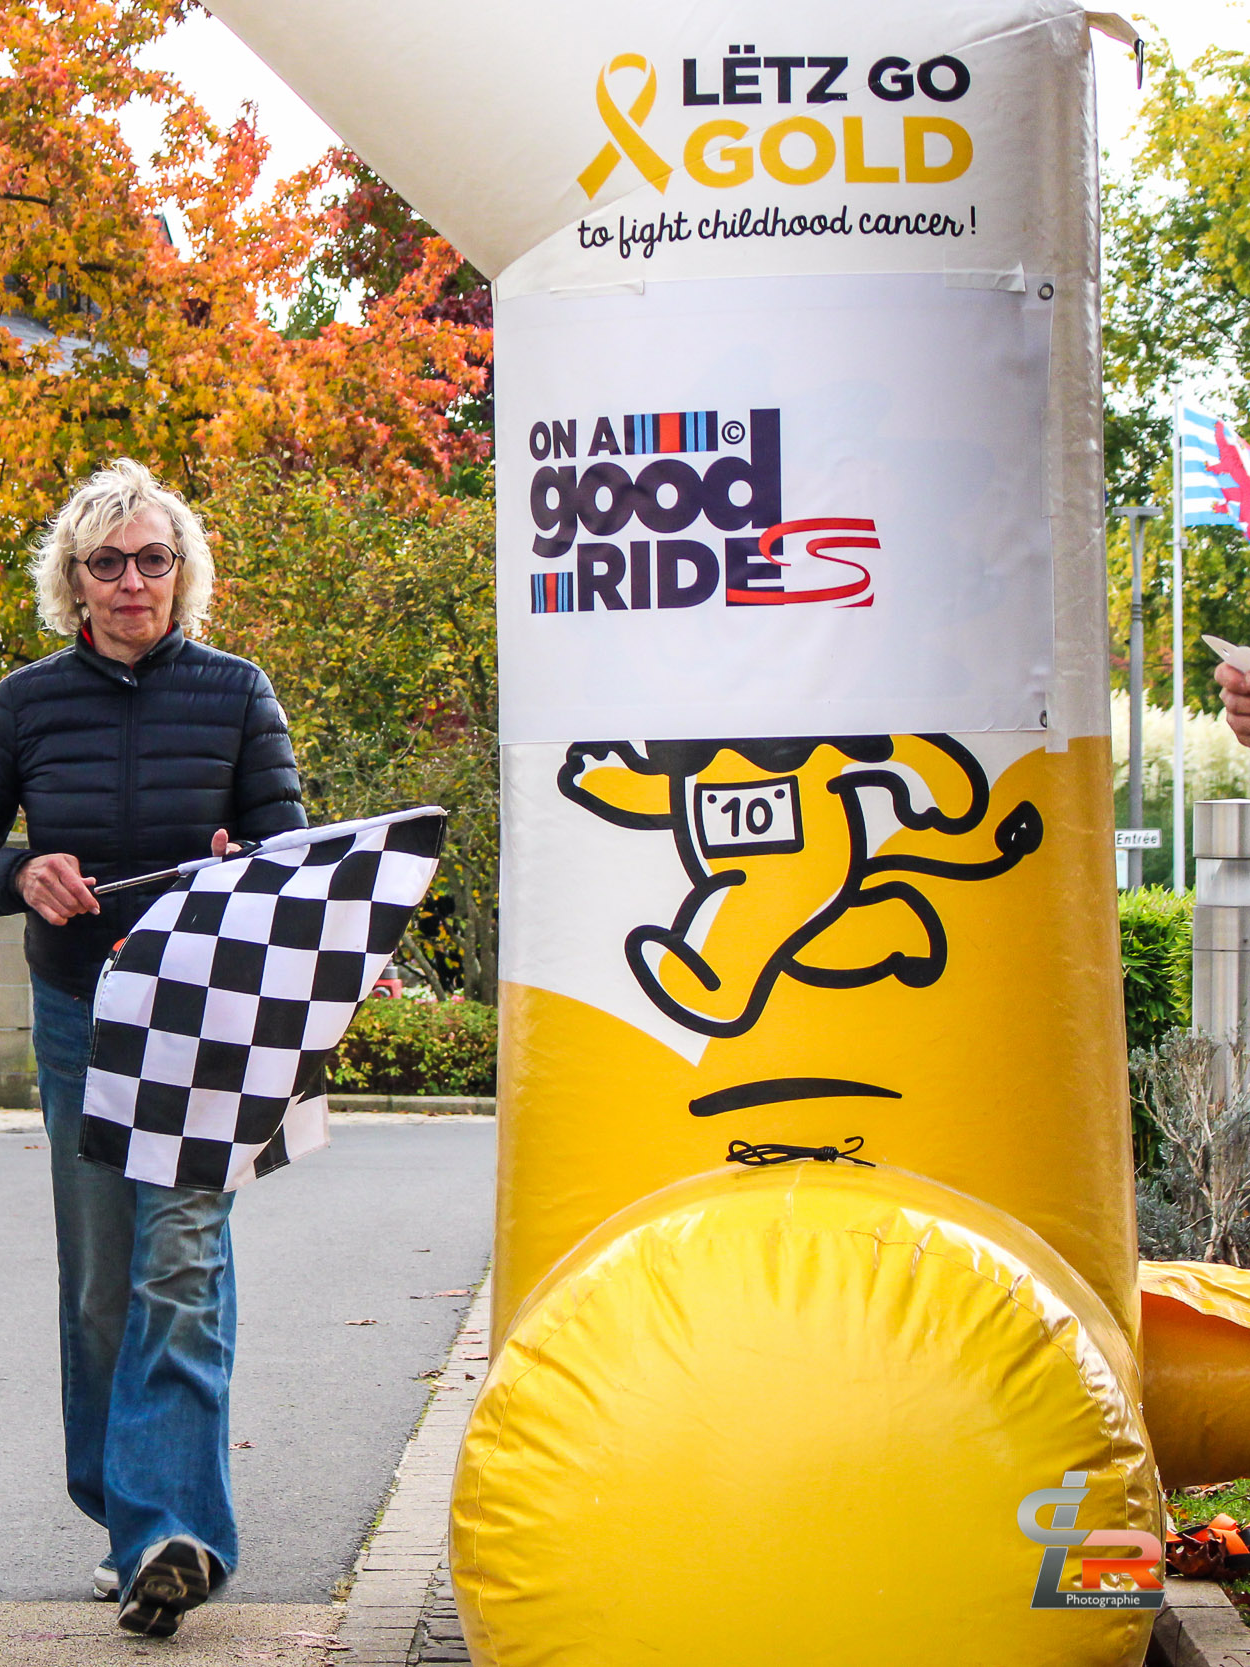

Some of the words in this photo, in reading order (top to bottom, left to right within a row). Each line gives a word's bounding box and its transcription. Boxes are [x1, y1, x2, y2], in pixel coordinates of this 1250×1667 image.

[682, 44, 849, 107] LËTZ
[867, 54, 971, 103] GO
[682, 115, 974, 189] GOLD
[577, 218, 615, 250] to
[618, 209, 692, 260] fight
[697, 204, 852, 240] childhood
[529, 418, 577, 461] ON
[587, 416, 622, 456] A
[530, 408, 783, 559] good
[720, 796, 774, 837] 10
[1116, 832, 1158, 845] Entrée
